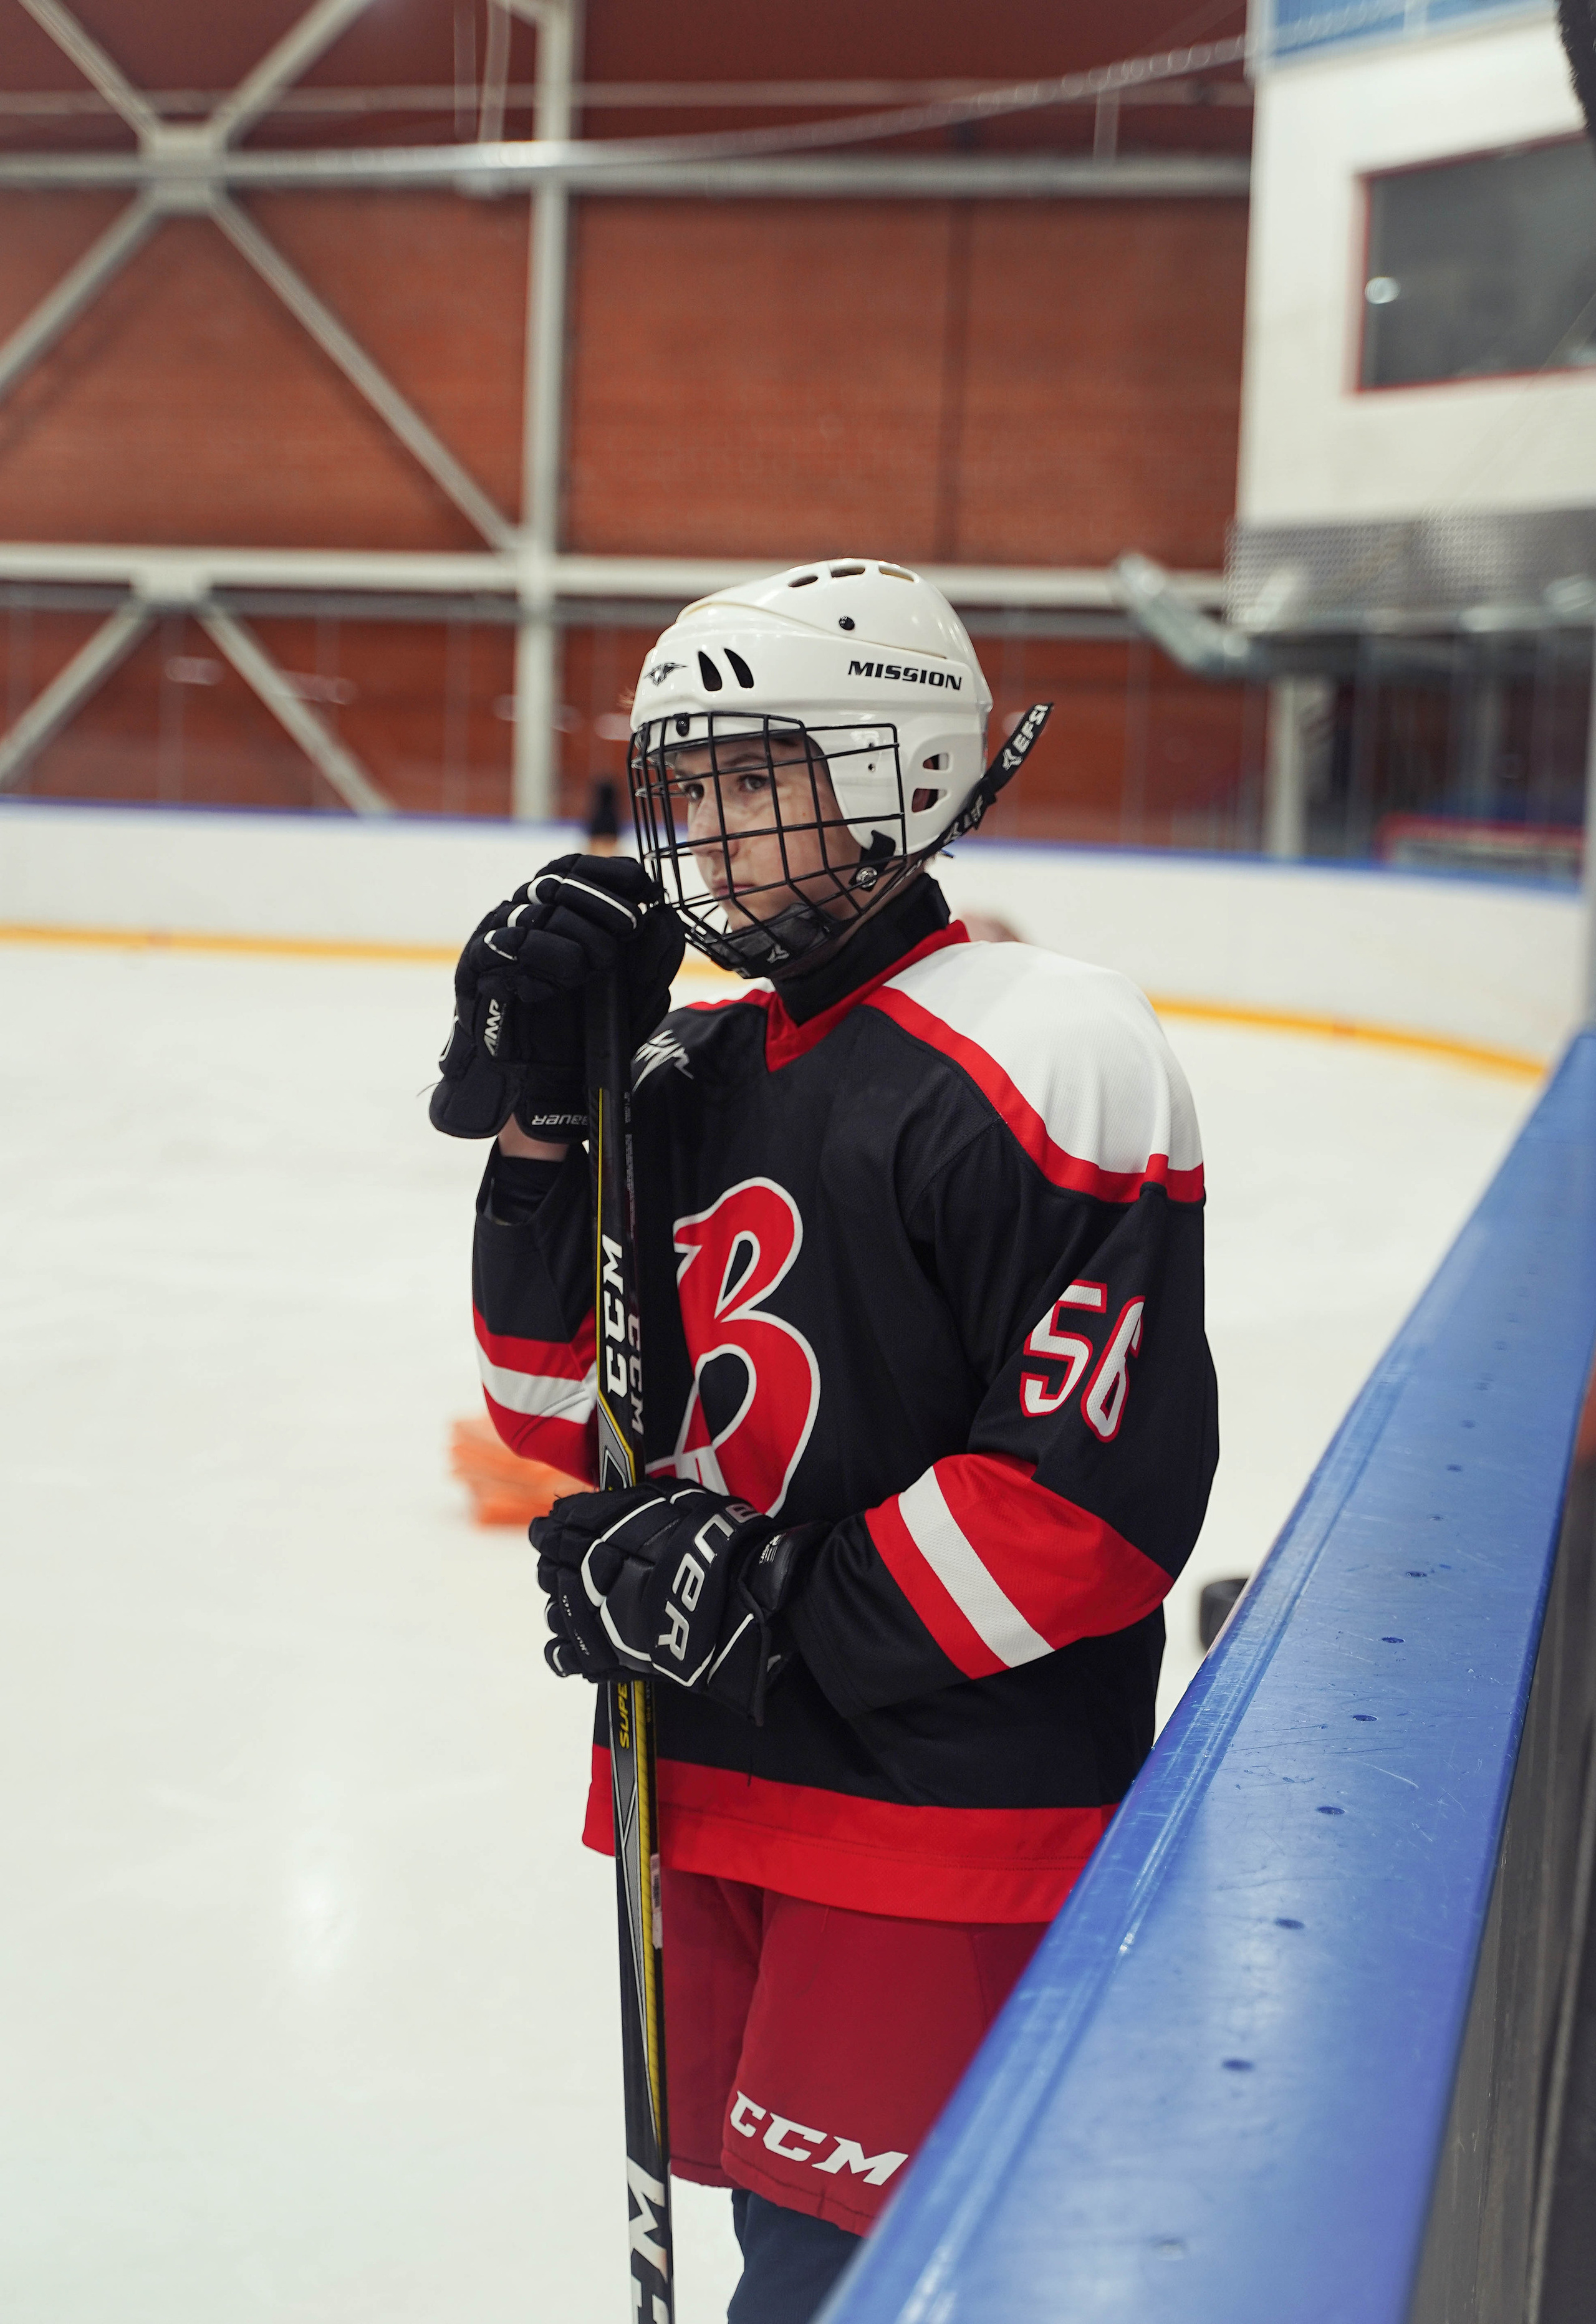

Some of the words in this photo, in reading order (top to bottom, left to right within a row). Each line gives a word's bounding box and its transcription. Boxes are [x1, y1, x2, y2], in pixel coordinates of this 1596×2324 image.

[848, 660, 963, 690] MISSION
[602, 1234, 628, 1398] CCM
[627, 1313, 645, 1436] CCM
[1019, 1279, 1146, 1443] 56
[729, 2090, 909, 2186] CCM
